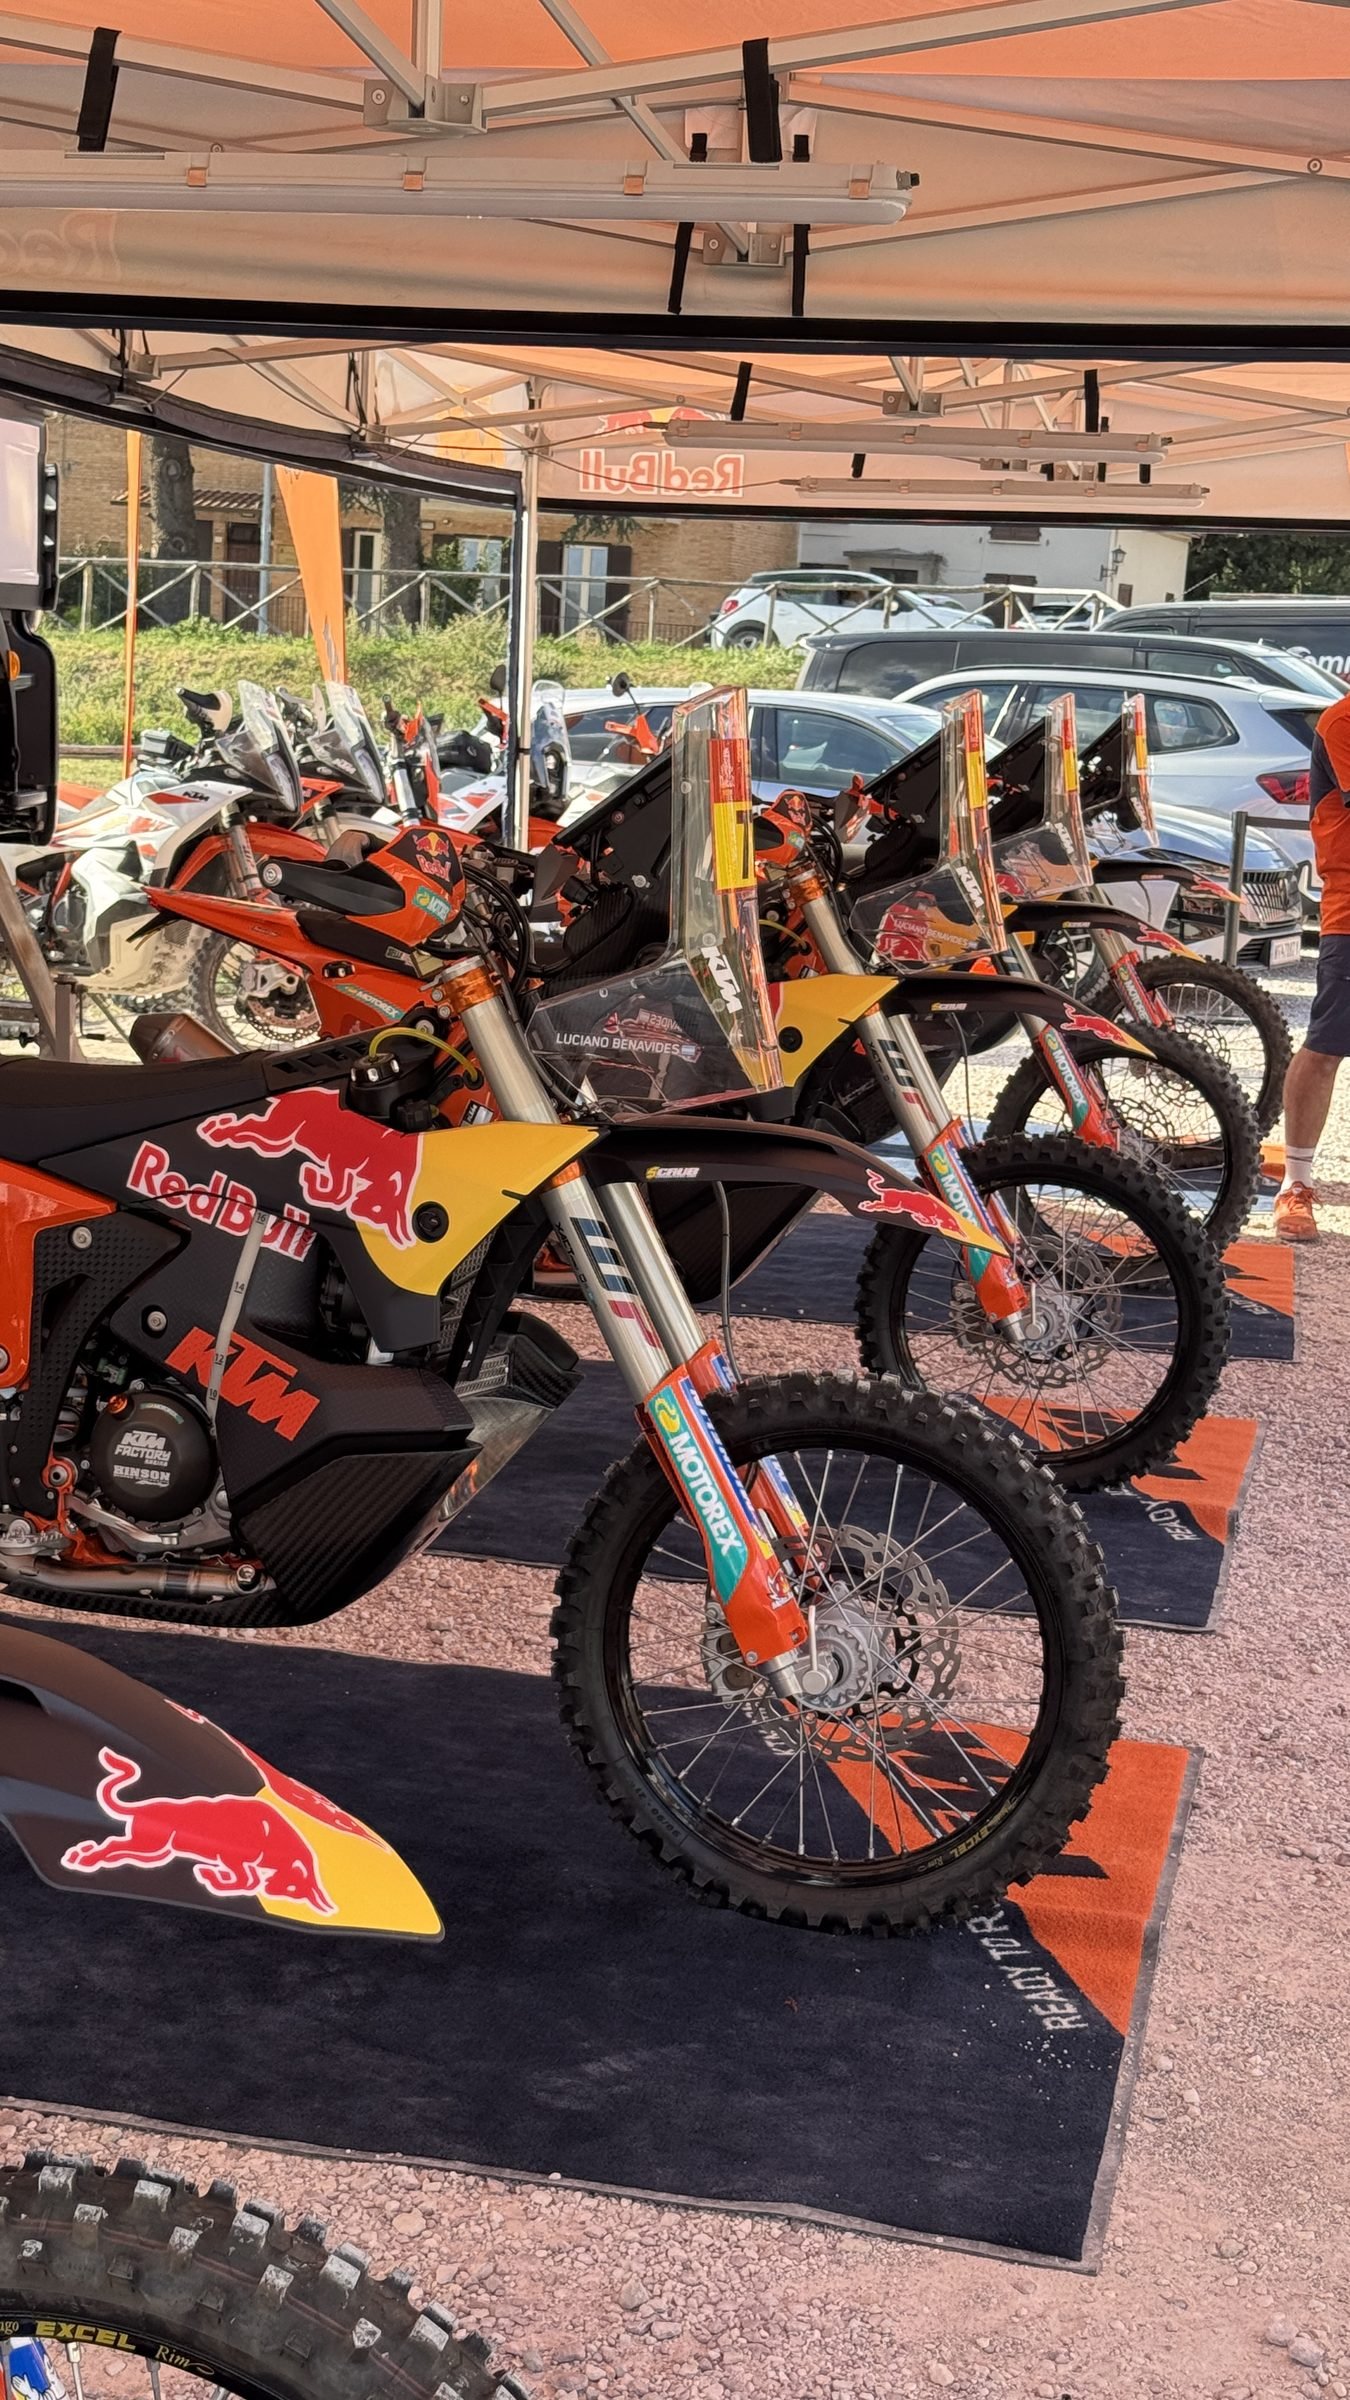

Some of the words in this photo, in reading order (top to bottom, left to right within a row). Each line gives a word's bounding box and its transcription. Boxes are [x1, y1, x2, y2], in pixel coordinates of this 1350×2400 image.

[182, 790, 210, 802] KTM
[956, 866, 984, 908] KTM
[893, 919, 927, 935] LUCIANO
[926, 929, 969, 947] BENAVIDES
[701, 945, 743, 1014] KTM
[356, 991, 400, 1019] MOTOREX
[556, 1033, 609, 1049] LUCIANO
[611, 1037, 681, 1055] BENAVIDES
[1053, 1050, 1087, 1106] MOTOREX
[256, 1211, 267, 1225] 16
[234, 1281, 245, 1294] 14
[215, 1353, 225, 1365] 12
[164, 1326, 320, 1442] KTM
[209, 1388, 218, 1400] 10
[114, 1444, 172, 1461] FACTORY
[121, 1430, 167, 1450] KTM
[113, 1465, 171, 1480] HINSON
[669, 1431, 743, 1556] MOTOREX
[950, 1827, 991, 1859] EXCEL
[979, 1937, 1032, 1961] TO
[1000, 1965, 1089, 2031] READY
[35, 2320, 137, 2351] EXCEL
[155, 2344, 191, 2368] Rim
